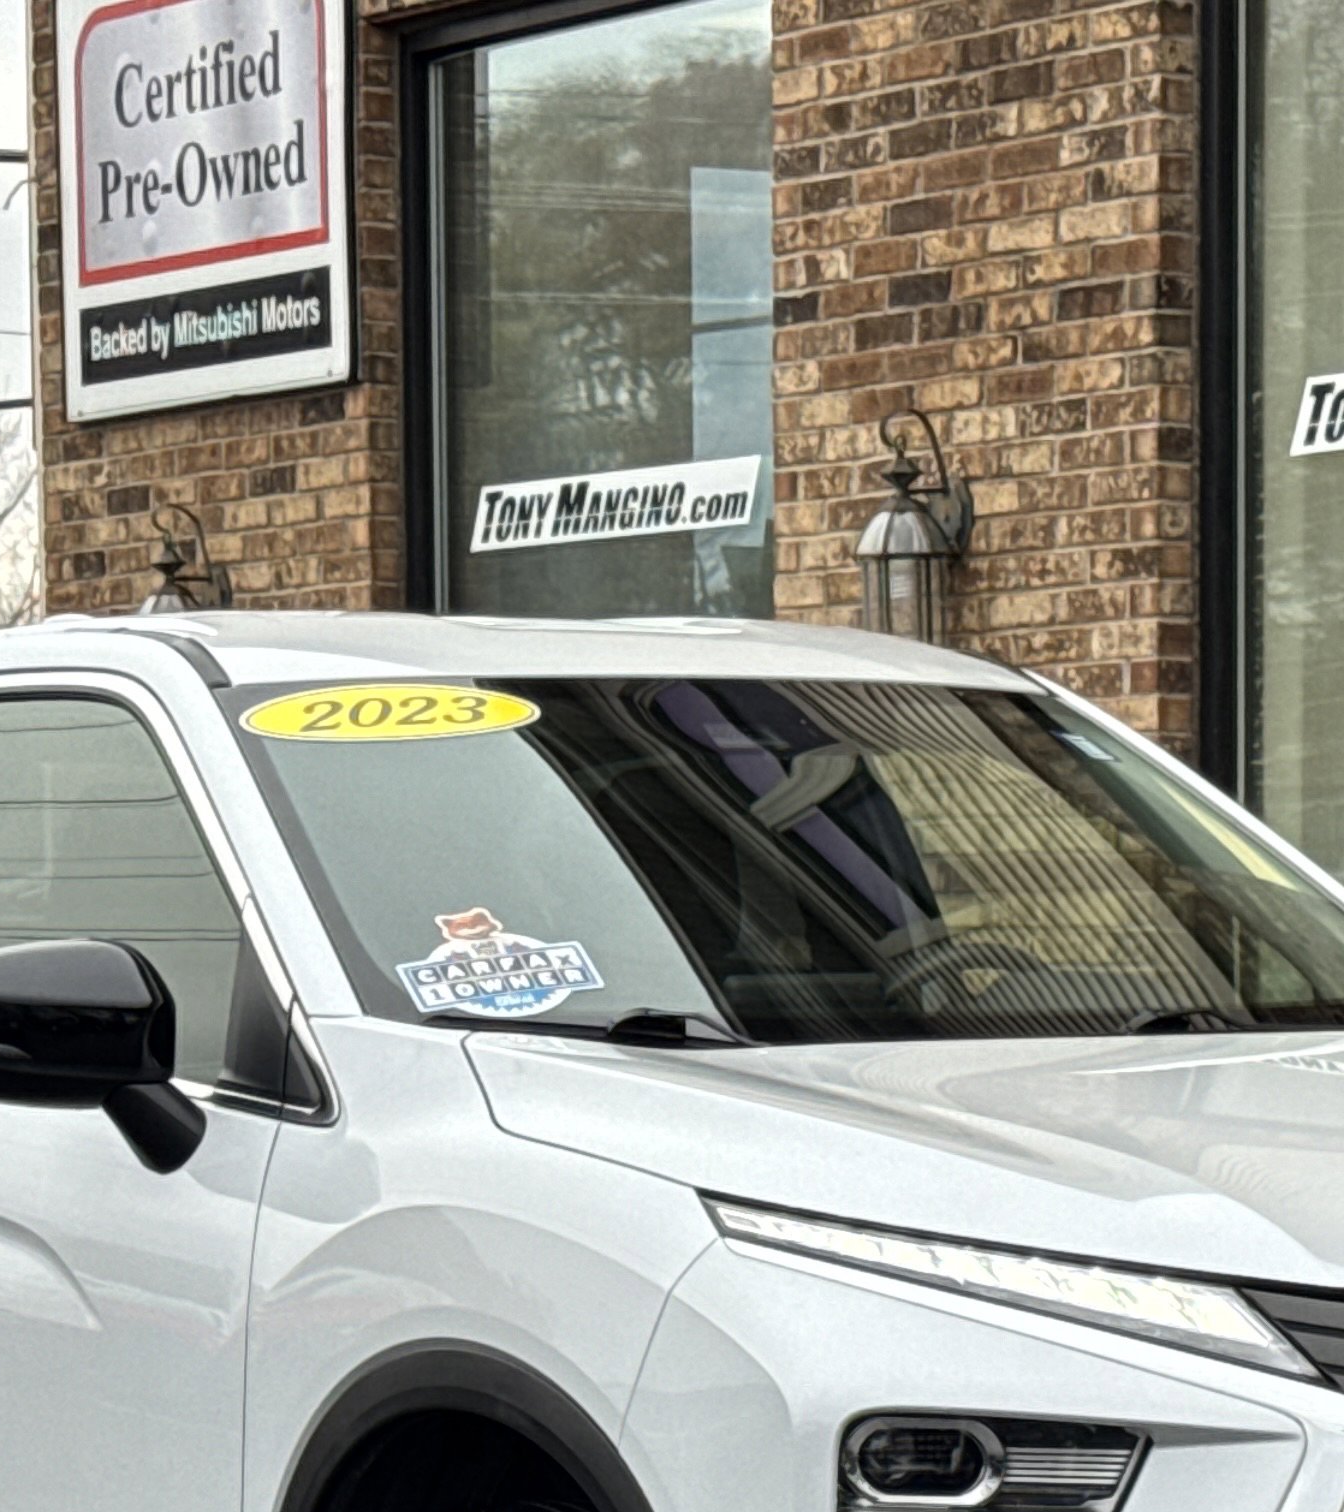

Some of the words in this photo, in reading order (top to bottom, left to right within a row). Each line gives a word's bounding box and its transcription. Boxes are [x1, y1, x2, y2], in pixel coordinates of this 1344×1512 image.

[114, 29, 282, 128] Certified
[98, 119, 308, 224] Pre-Owned
[90, 317, 148, 362] Backed
[150, 316, 170, 360] by
[174, 299, 257, 348] Mitsubishi
[261, 294, 321, 333] Motors
[481, 490, 554, 544] TONY
[551, 481, 749, 537] MANGINO.com
[299, 695, 488, 733] 2023
[416, 954, 577, 985] CARFAX
[454, 968, 587, 998] OWNER
